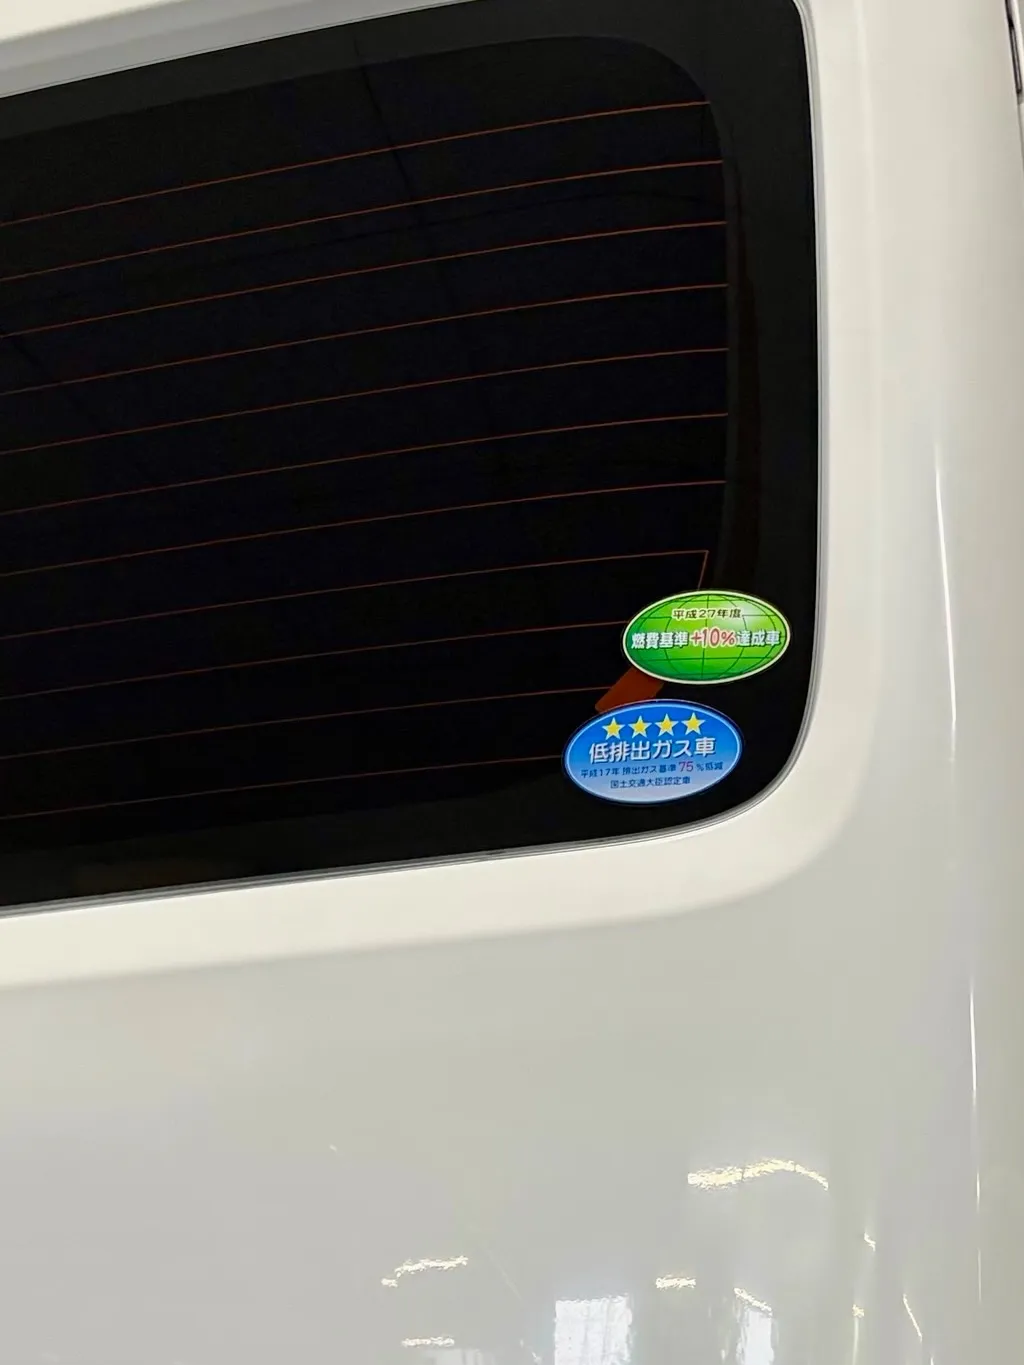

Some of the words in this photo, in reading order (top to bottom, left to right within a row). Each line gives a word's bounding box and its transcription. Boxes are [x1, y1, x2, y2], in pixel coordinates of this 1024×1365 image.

[672, 608, 742, 620] 平成27年度
[589, 737, 716, 764] 低排出ガス車
